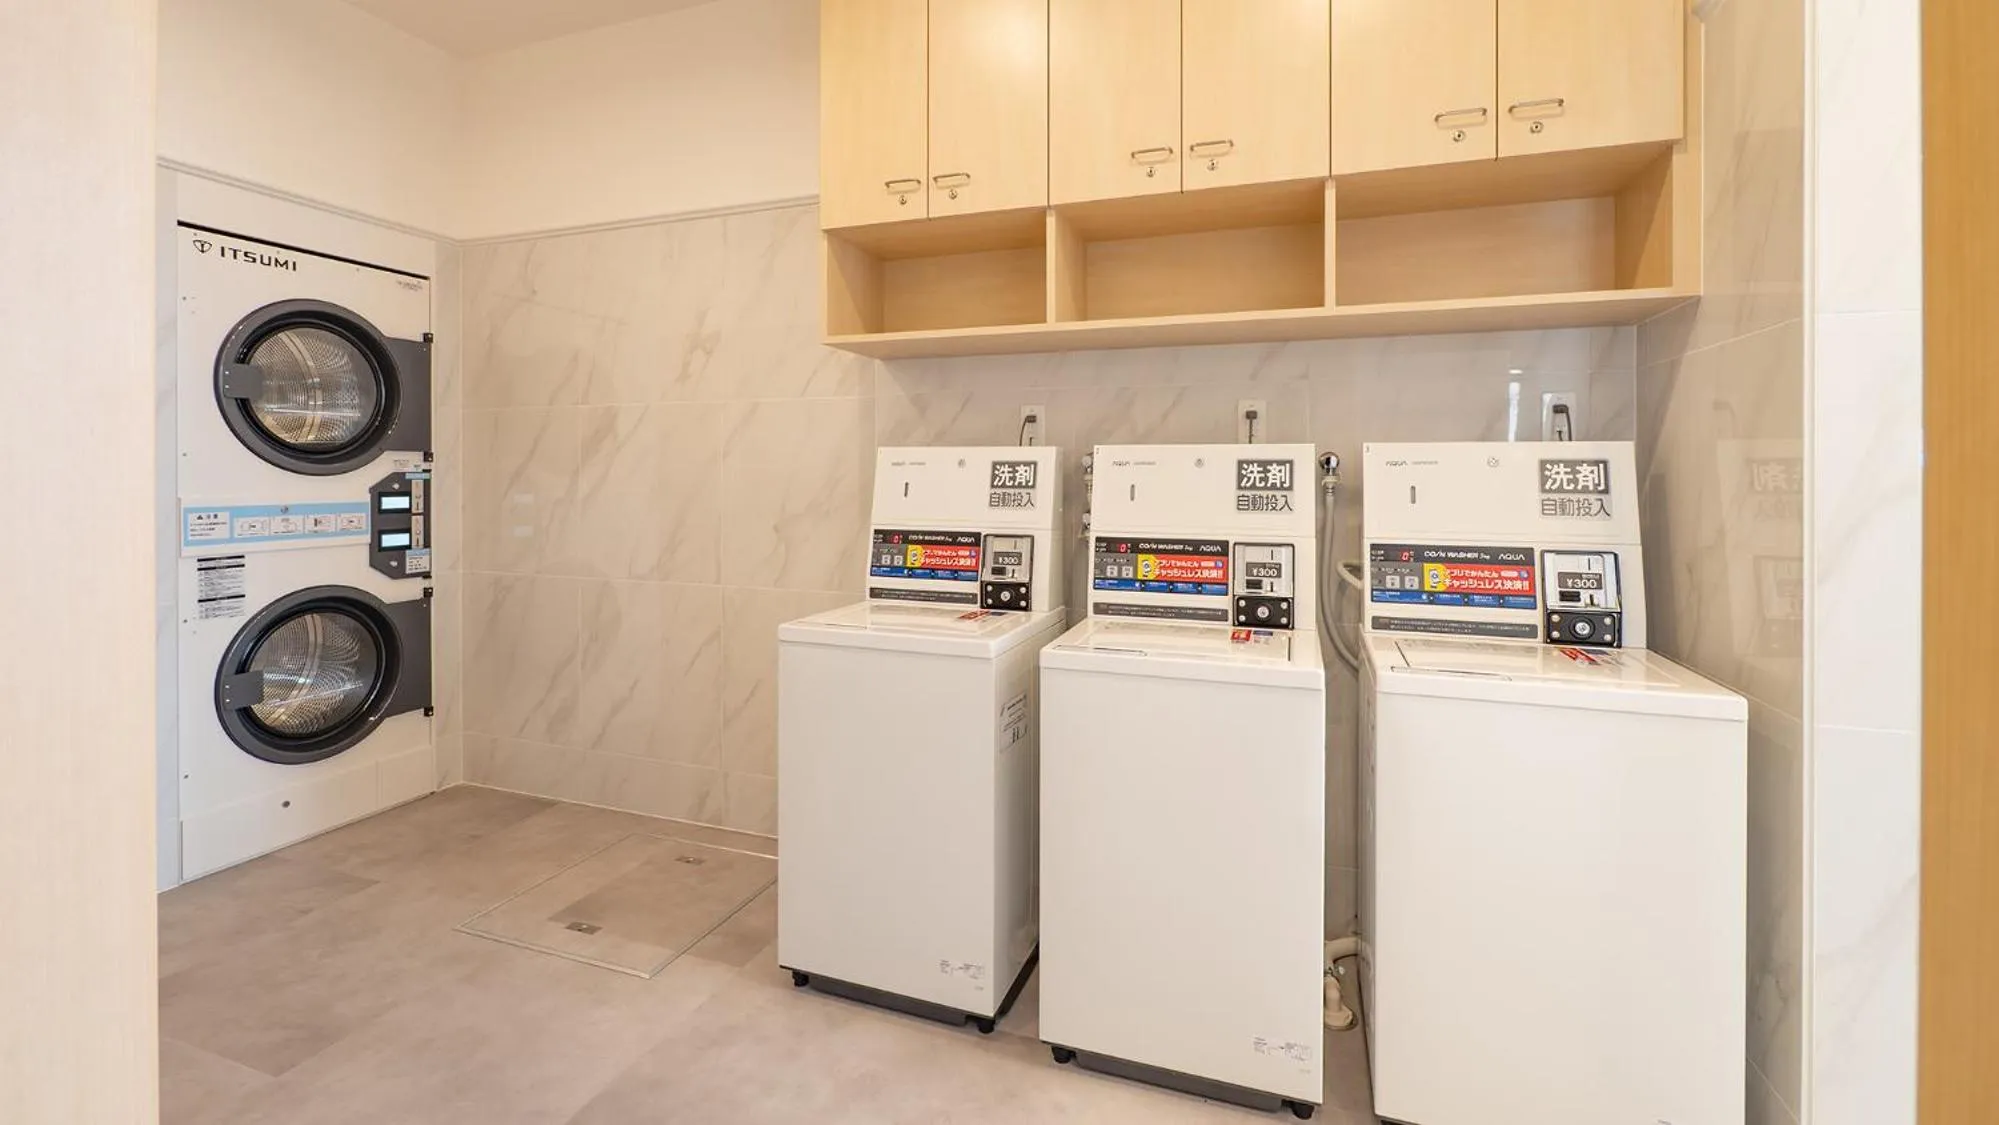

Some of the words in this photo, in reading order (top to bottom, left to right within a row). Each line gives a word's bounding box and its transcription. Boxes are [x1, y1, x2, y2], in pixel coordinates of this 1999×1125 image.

[220, 245, 297, 272] ITSUMI
[992, 463, 1035, 488] 洗剤
[1240, 462, 1291, 489] 洗剤
[1543, 462, 1606, 491] 洗剤
[989, 492, 1036, 508] 自動投入
[1236, 493, 1294, 512] 自動投入
[1541, 498, 1612, 517] 自動投入
[1199, 544, 1222, 552] AQUA
[1498, 553, 1525, 561] AQUA
[1252, 567, 1278, 577] ¥300
[1566, 578, 1598, 589] ¥300
